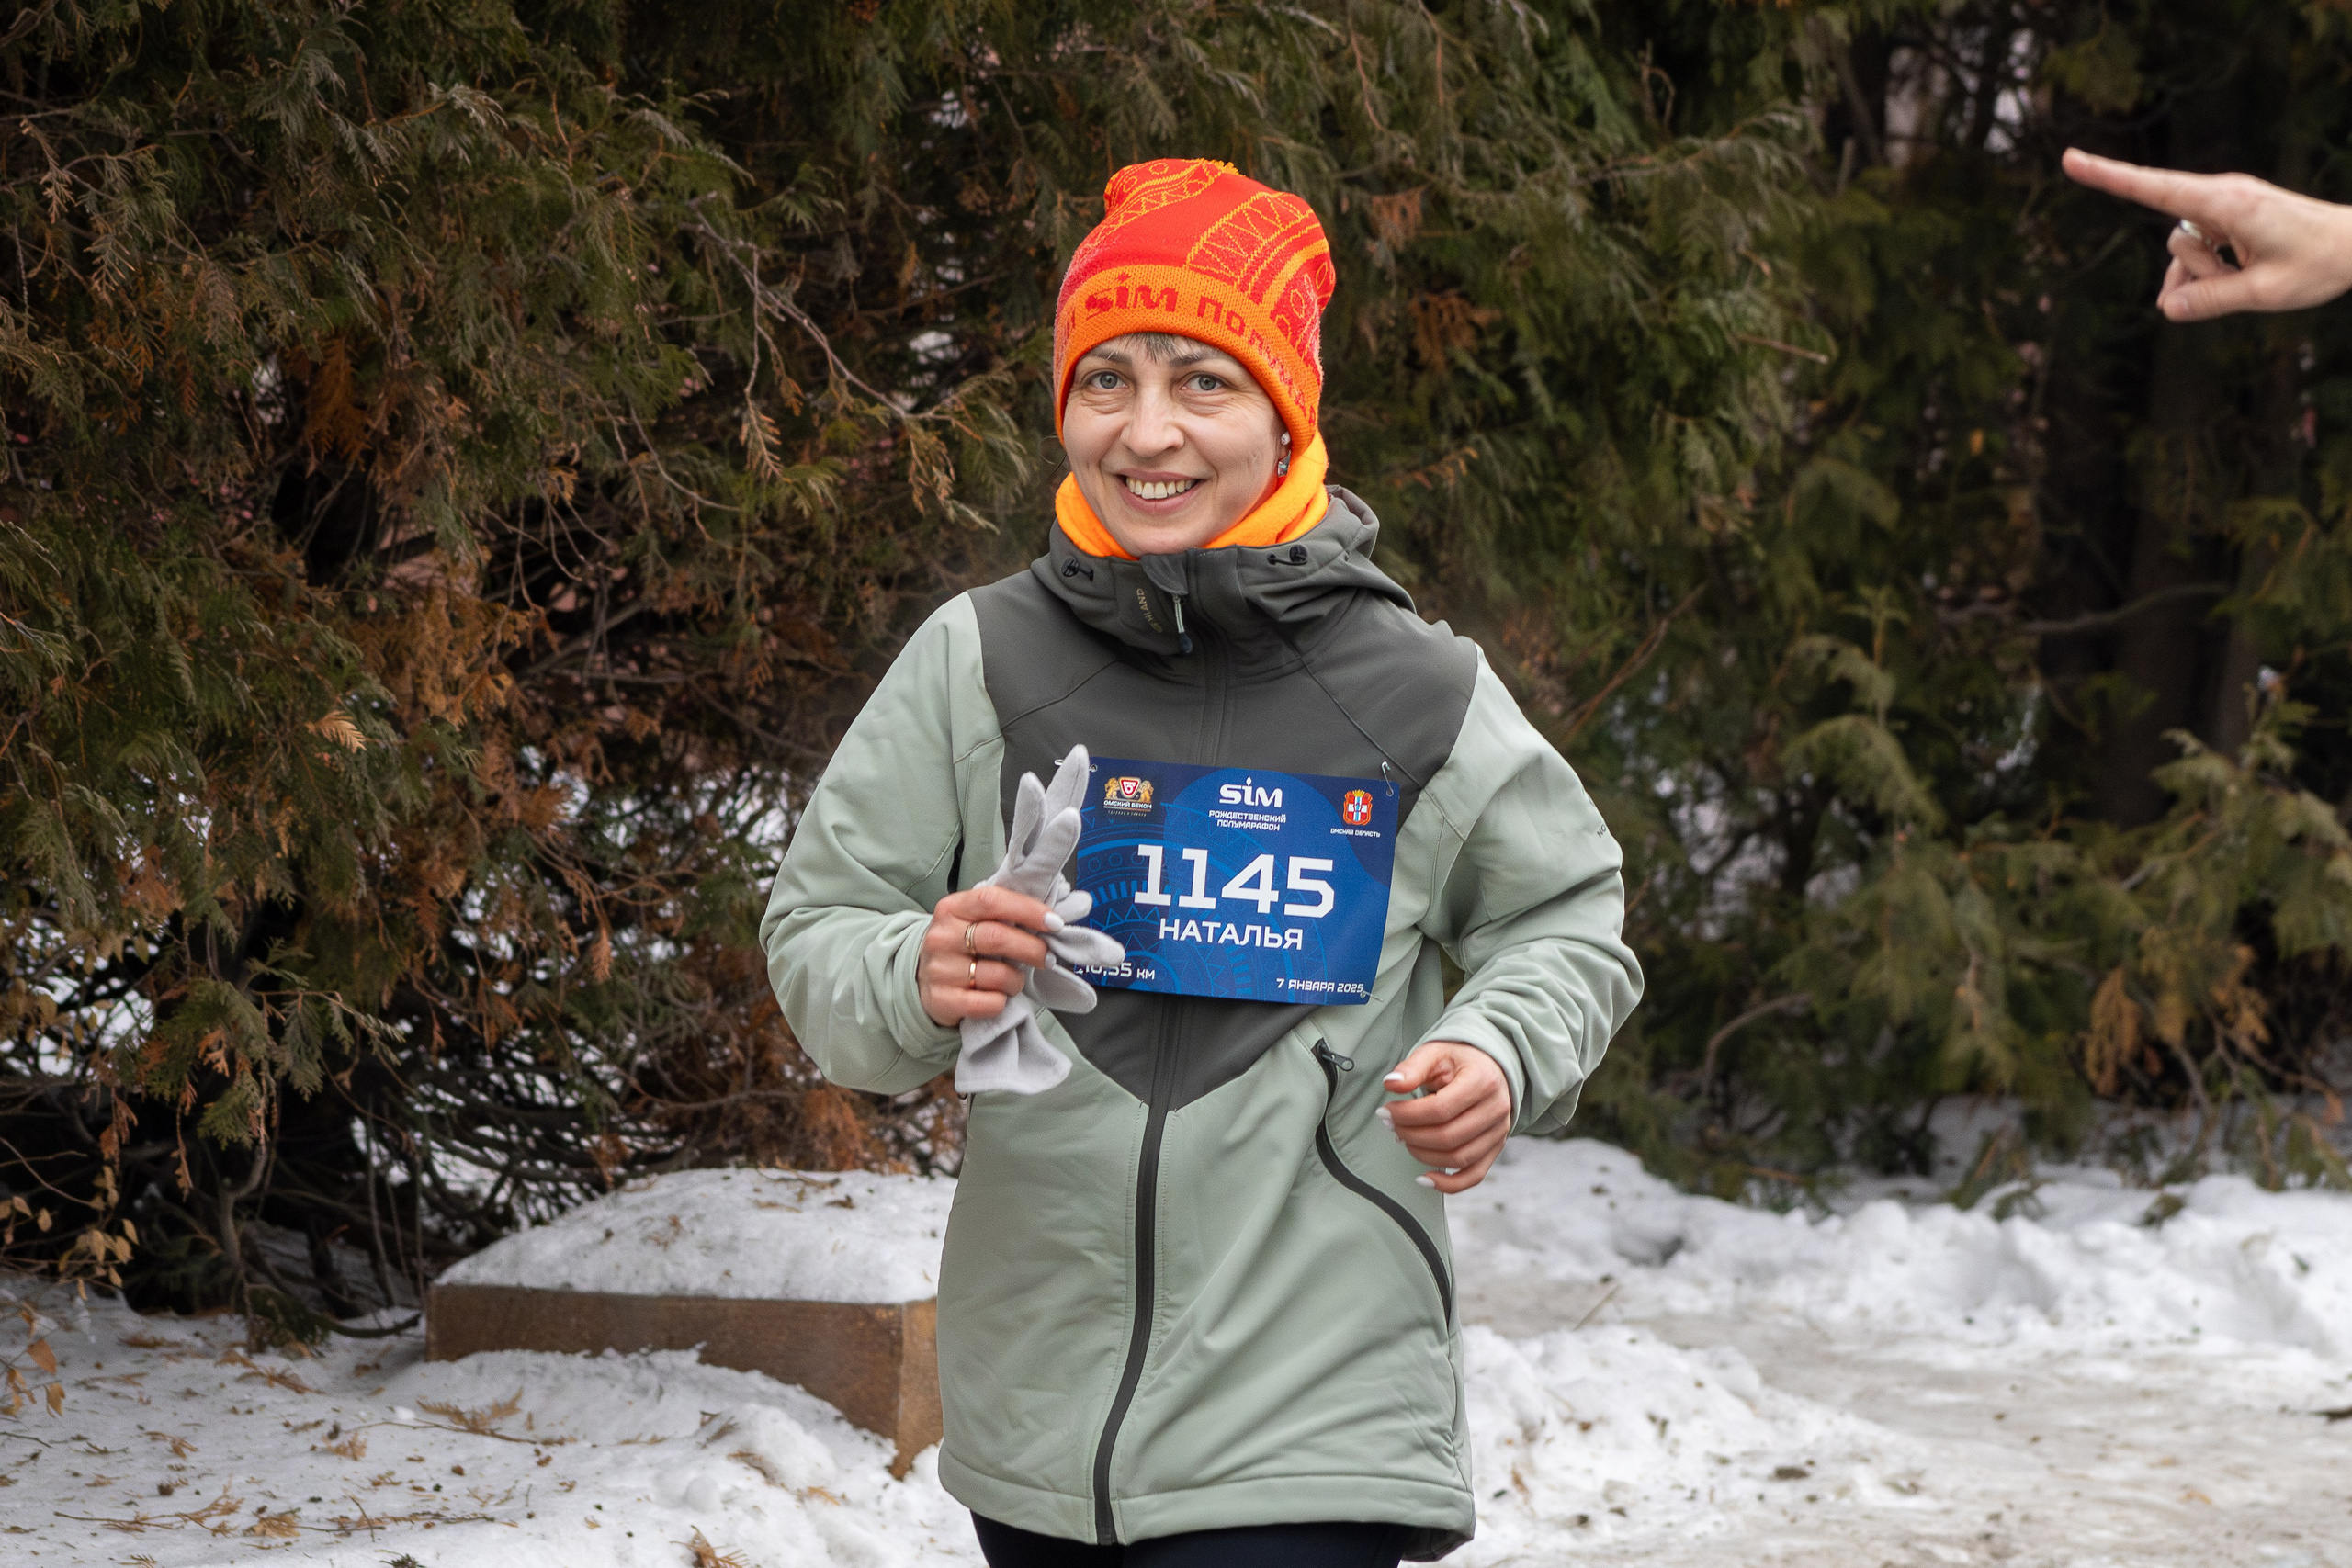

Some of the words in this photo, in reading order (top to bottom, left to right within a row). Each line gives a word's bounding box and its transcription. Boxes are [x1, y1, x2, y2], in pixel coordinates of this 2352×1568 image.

[1209, 810, 1286, 823] РОЖДЕСТВЕНСКИЙ
[1216, 819, 1280, 831] ПОЛУМАРАФОН
[1134, 843, 1335, 918] 1145
[1159, 918, 1303, 950] НАТАЛЬЯ
[1276, 977, 1284, 988] 7
[1288, 979, 1335, 992] ЯНВАРЯ
[1337, 983, 1364, 993] 2025
